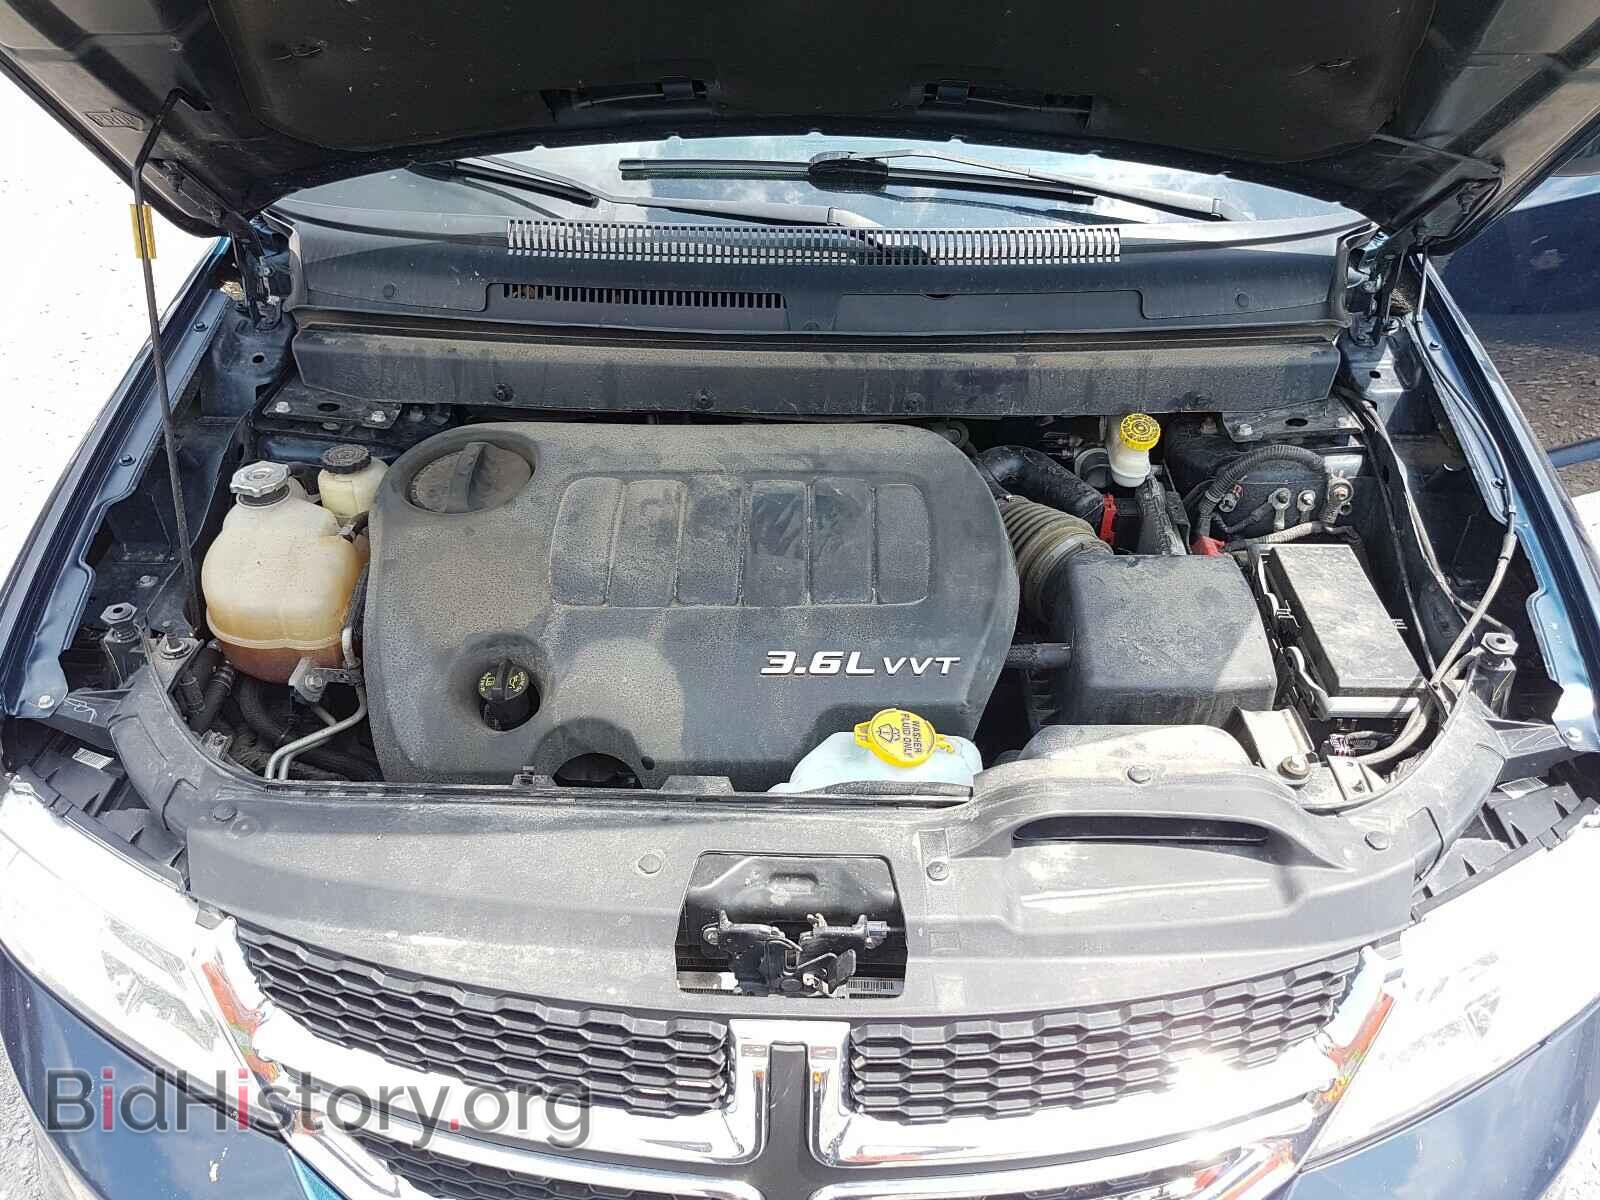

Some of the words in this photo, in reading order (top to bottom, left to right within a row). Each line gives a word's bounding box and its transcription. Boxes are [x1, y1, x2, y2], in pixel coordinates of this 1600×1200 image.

[760, 650, 875, 676] 3.6L
[883, 656, 961, 675] VVT
[901, 713, 911, 735] FLUID
[904, 738, 913, 758] ONLY
[911, 721, 921, 752] WASHER
